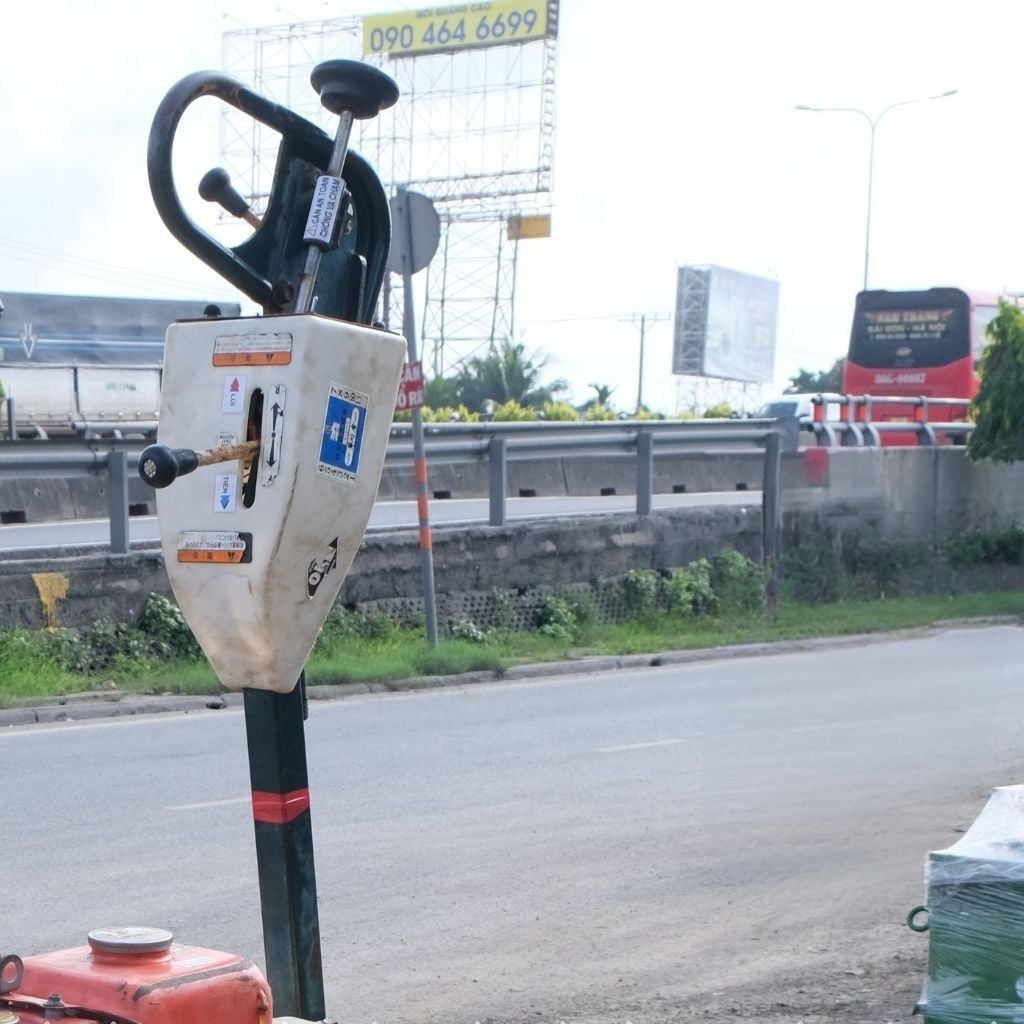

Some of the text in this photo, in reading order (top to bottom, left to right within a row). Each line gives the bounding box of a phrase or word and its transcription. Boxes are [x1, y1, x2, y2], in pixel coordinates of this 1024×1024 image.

[370, 8, 538, 52] 090 464 6699
